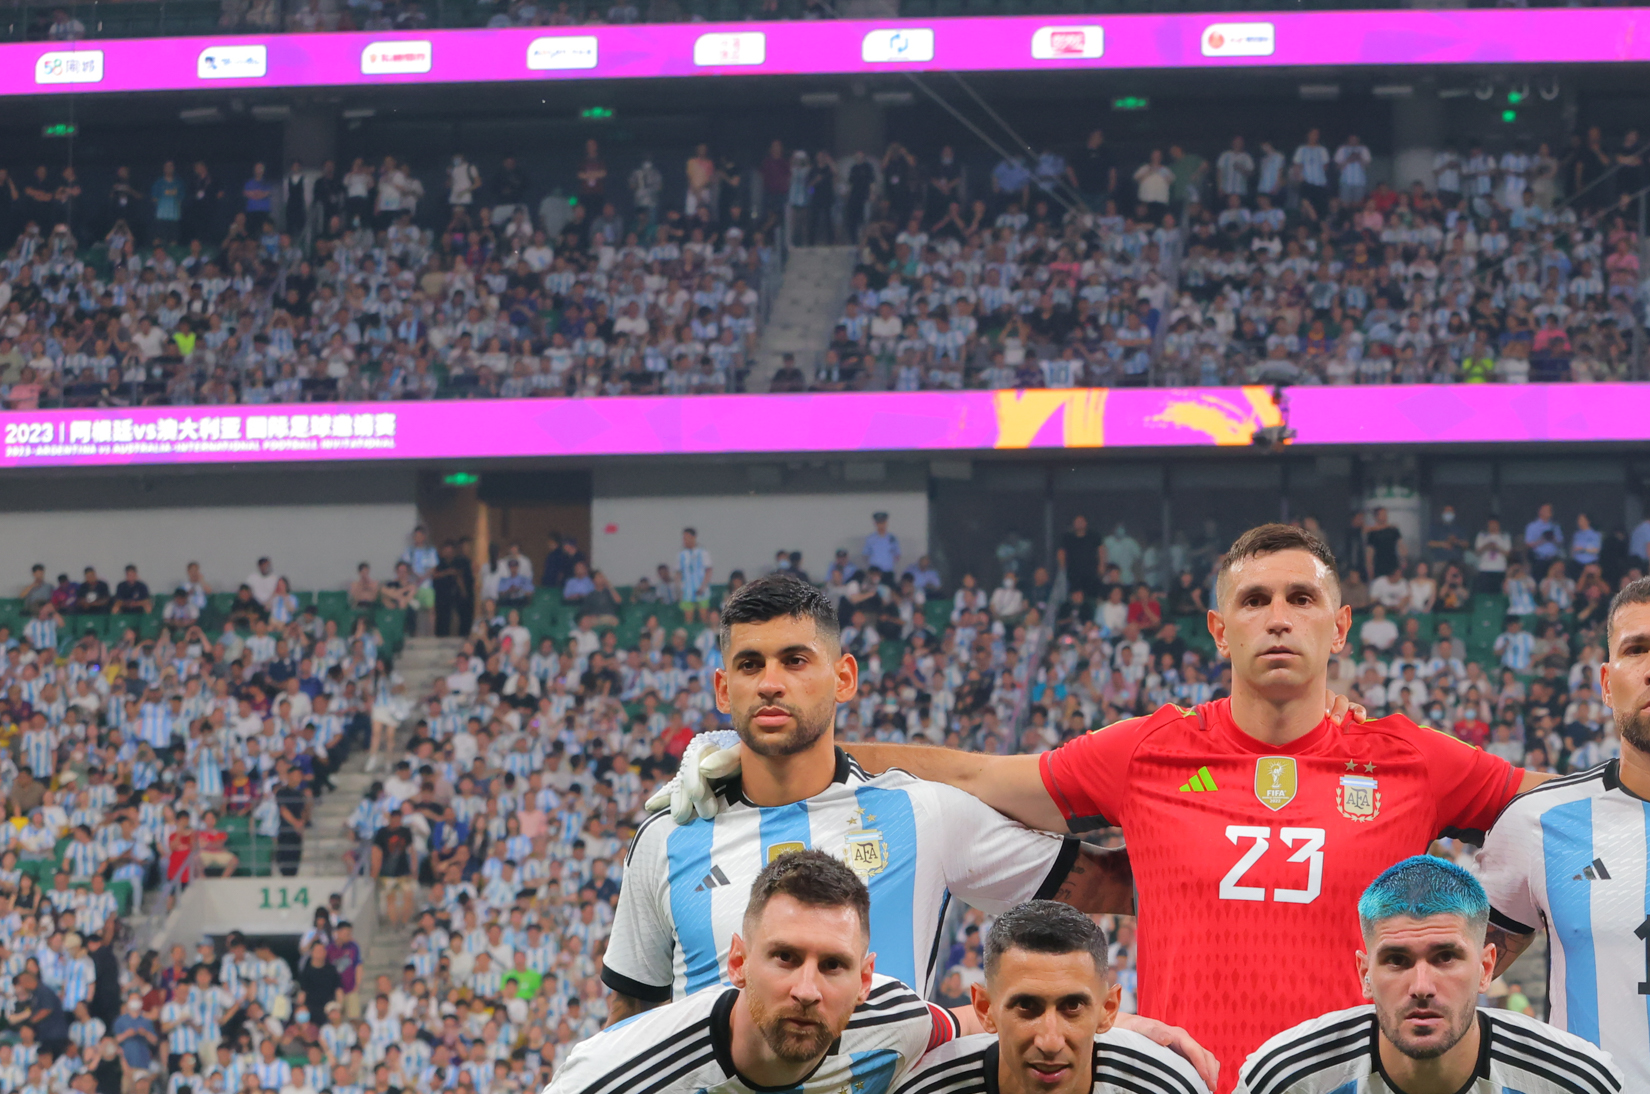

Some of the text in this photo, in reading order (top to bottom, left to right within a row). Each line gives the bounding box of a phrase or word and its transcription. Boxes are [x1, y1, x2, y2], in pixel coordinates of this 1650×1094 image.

[5, 422, 54, 444] 2023
[1346, 787, 1371, 809] AFA
[854, 842, 879, 864] AFA
[1219, 825, 1326, 904] 23
[259, 887, 309, 909] 114
